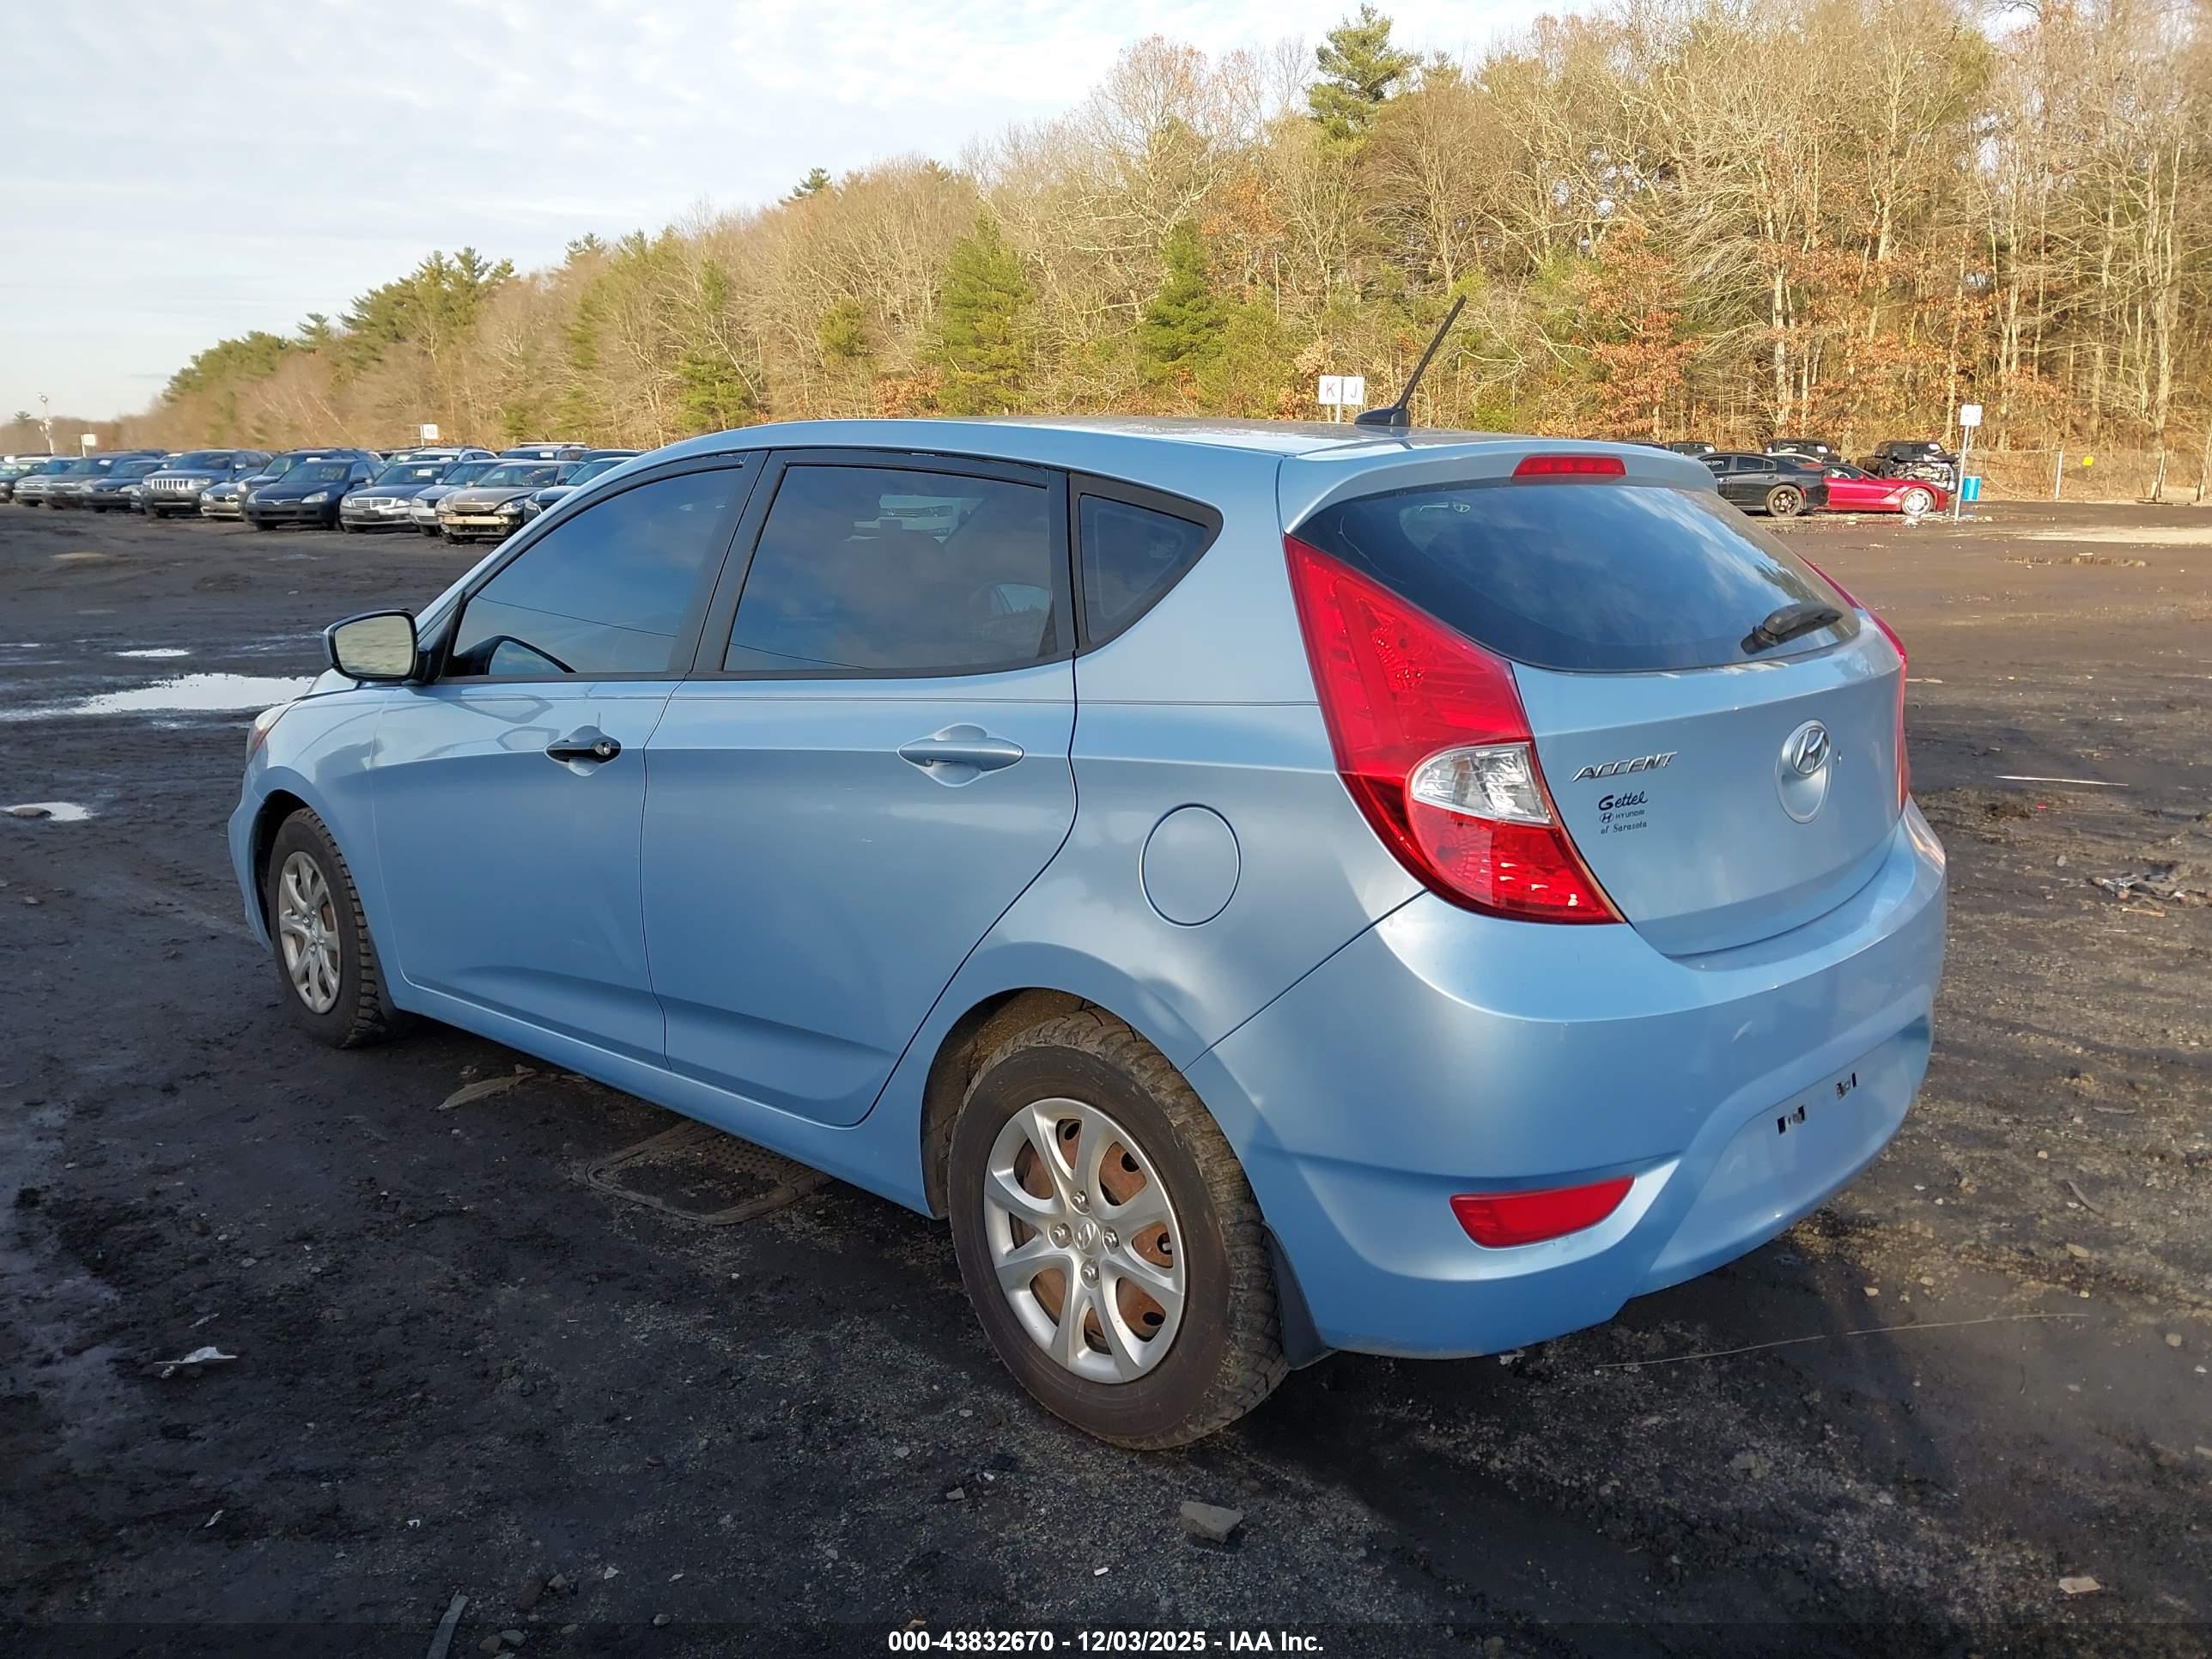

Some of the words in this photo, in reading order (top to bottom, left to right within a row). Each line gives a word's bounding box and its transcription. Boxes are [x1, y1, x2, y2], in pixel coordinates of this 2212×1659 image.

[1326, 383, 1335, 398] K
[1350, 383, 1358, 398] J
[1570, 750, 1679, 783] ACCENT
[1598, 790, 1649, 811] Gettel
[1601, 824, 1610, 834] of
[1613, 820, 1647, 833] Sarasota
